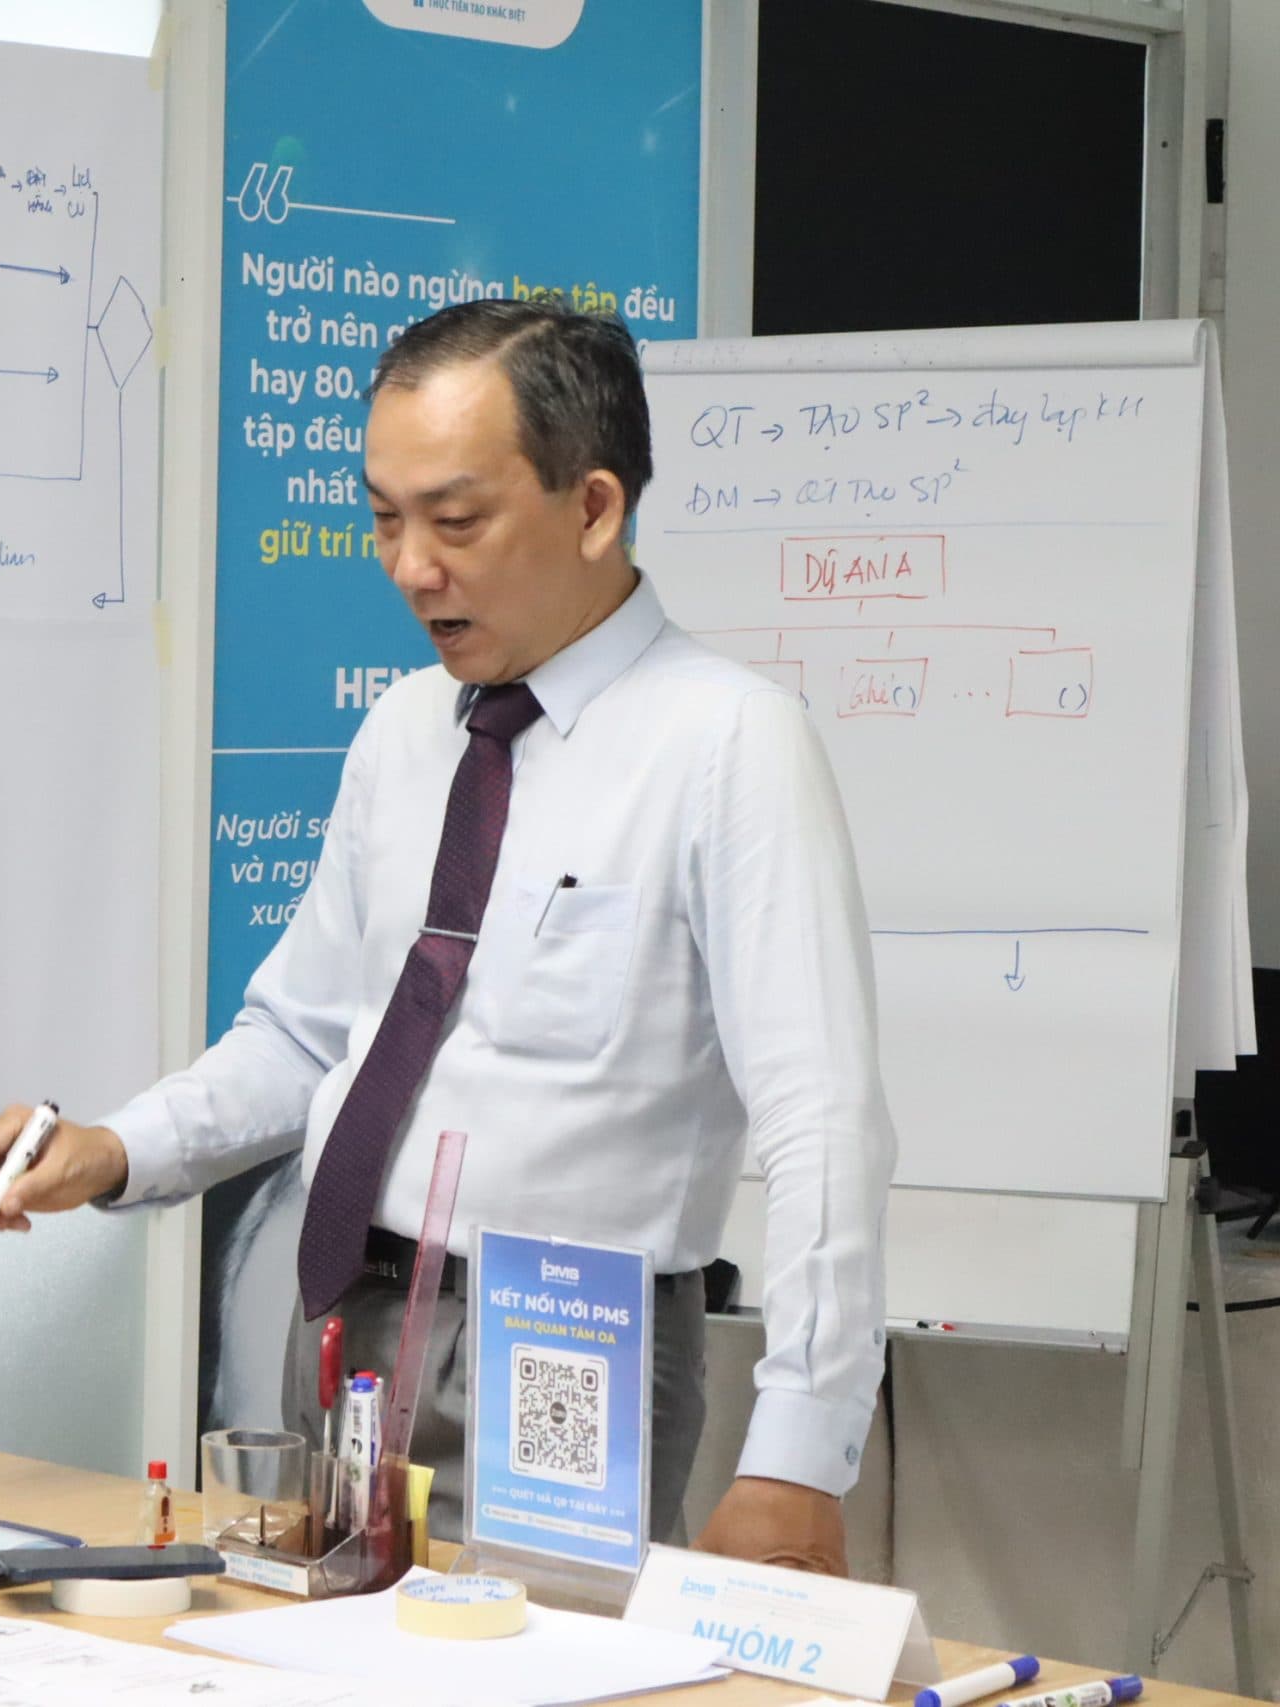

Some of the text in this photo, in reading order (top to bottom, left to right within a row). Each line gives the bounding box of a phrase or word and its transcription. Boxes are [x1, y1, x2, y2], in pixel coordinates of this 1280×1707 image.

[242, 252, 334, 296] Người
[345, 262, 399, 298] nào
[624, 286, 675, 321] đều
[267, 312, 311, 344] trở
[321, 317, 378, 348] nên
[250, 358, 306, 404] hay
[314, 365, 361, 400] 80.
[243, 413, 362, 457] tập đều
[690, 405, 755, 449] QT
[287, 467, 358, 505] nhất
[260, 519, 312, 564] giữ
[319, 523, 354, 558] trí
[216, 810, 301, 847] Người
[231, 854, 264, 883] và
[489, 1287, 630, 1326] KẾT NỐI VỚI PMS
[799, 1642, 822, 1675] 2
